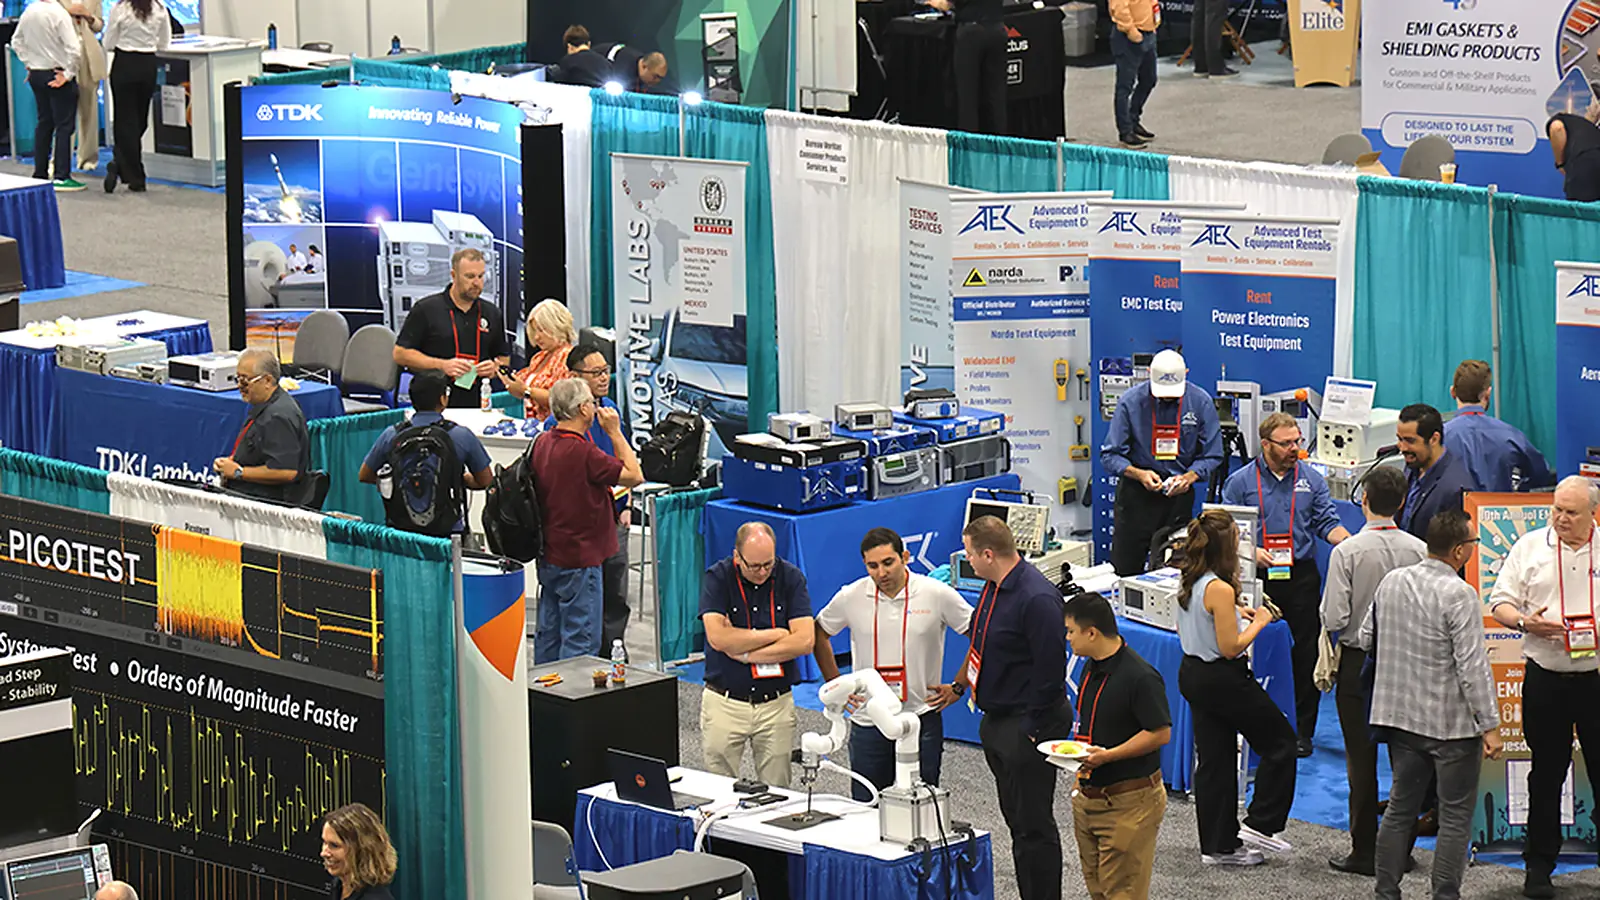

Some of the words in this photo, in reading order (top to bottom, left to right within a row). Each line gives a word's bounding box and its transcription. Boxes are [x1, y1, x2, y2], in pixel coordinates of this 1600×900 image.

[1301, 12, 1344, 30] Elite
[1406, 22, 1433, 36] EMI
[1436, 23, 1504, 38] GASKETS
[1507, 24, 1518, 39] &
[1381, 41, 1459, 58] SHIELDING
[1462, 44, 1541, 62] PRODUCTS
[1388, 67, 1420, 78] Custom
[1423, 69, 1437, 78] and
[1440, 69, 1494, 80] Off-the-Shelf
[1496, 72, 1531, 82] Products
[1382, 80, 1394, 89] for
[1396, 80, 1444, 91] Commercial
[1455, 82, 1487, 94] Military
[1488, 84, 1538, 96] Applications
[272, 104, 323, 120] TDK
[368, 105, 432, 125] Innovating
[436, 111, 473, 128] Reliable
[474, 116, 501, 134] Power
[1404, 120, 1453, 131] DESIGNED
[1455, 122, 1467, 132] TO
[1470, 124, 1494, 133] LAST
[1496, 124, 1514, 134] THE
[1475, 136, 1514, 146] SYSTEM
[909, 207, 938, 222] TESTING
[1033, 205, 1078, 216] Advanced
[909, 219, 943, 234] SERVICES
[1030, 218, 1078, 229] Equipment
[1254, 225, 1300, 238] Advanced
[1302, 226, 1322, 239] Test
[1244, 237, 1294, 250] Equipment
[1296, 238, 1332, 251] Rentals
[628, 219, 651, 304] LABS
[988, 266, 1023, 278] narda
[1154, 274, 1179, 288] Rent
[1031, 299, 1063, 308] Authorized
[1064, 298, 1085, 306] Service
[1122, 296, 1141, 310] EMC
[1143, 298, 1164, 310] Test
[1246, 290, 1272, 304] Rent
[985, 301, 1016, 309] Distributor
[1212, 310, 1246, 324] Power
[1248, 311, 1310, 328] Electronics
[991, 330, 1014, 339] Narda
[1016, 330, 1032, 339] Test
[1034, 328, 1076, 339] Equipment
[1220, 332, 1242, 348] Test
[1244, 334, 1302, 351] Equipment
[963, 357, 1000, 366] Wideband
[8, 529, 141, 586] PICOTEST
[15, 668, 42, 682] Step
[1506, 668, 1522, 678] Join
[9, 683, 58, 702] Stability
[127, 660, 183, 692] Orders
[186, 675, 206, 697] of
[207, 678, 300, 718] Magnitude
[304, 700, 358, 733] Faster
